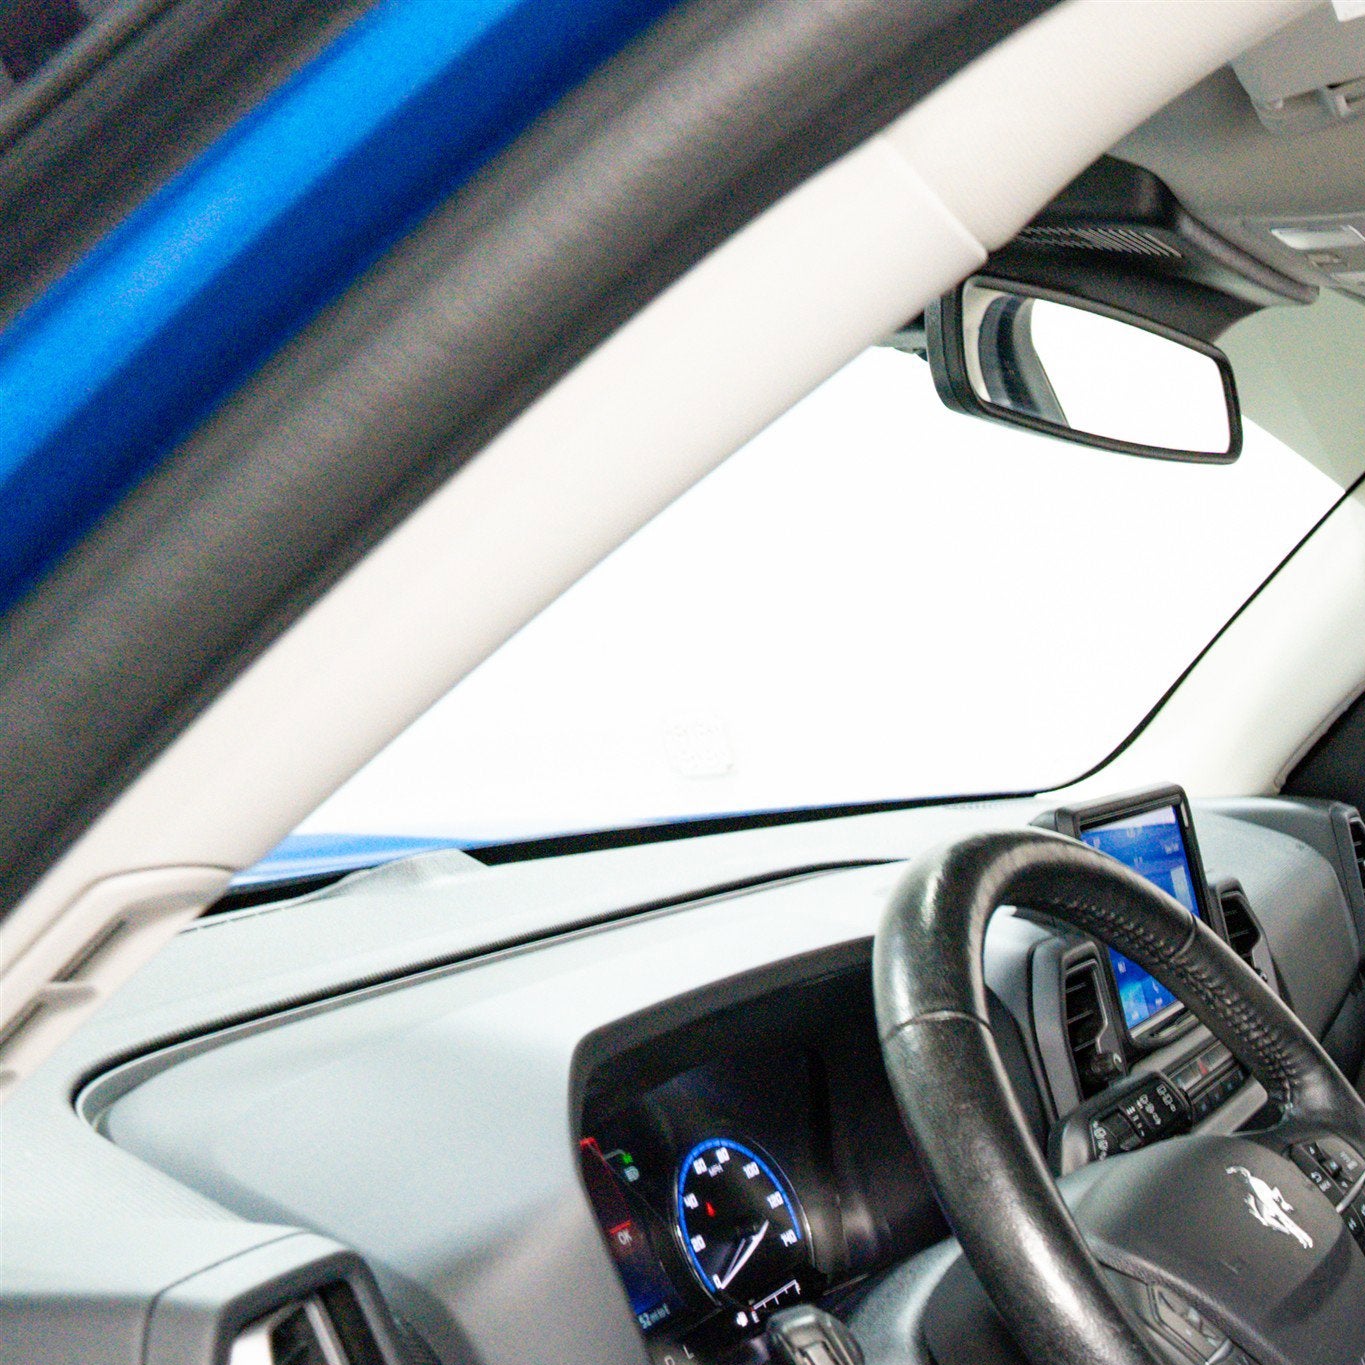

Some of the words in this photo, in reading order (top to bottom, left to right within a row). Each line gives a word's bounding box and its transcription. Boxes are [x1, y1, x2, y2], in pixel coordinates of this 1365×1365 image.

[716, 1147, 730, 1164] 80
[693, 1157, 707, 1175] 60
[743, 1162, 760, 1179] 100
[683, 1193, 699, 1210] 40
[766, 1191, 784, 1209] 120
[618, 1229, 632, 1246] OK
[780, 1229, 797, 1247] 140
[712, 1274, 722, 1289] 0
